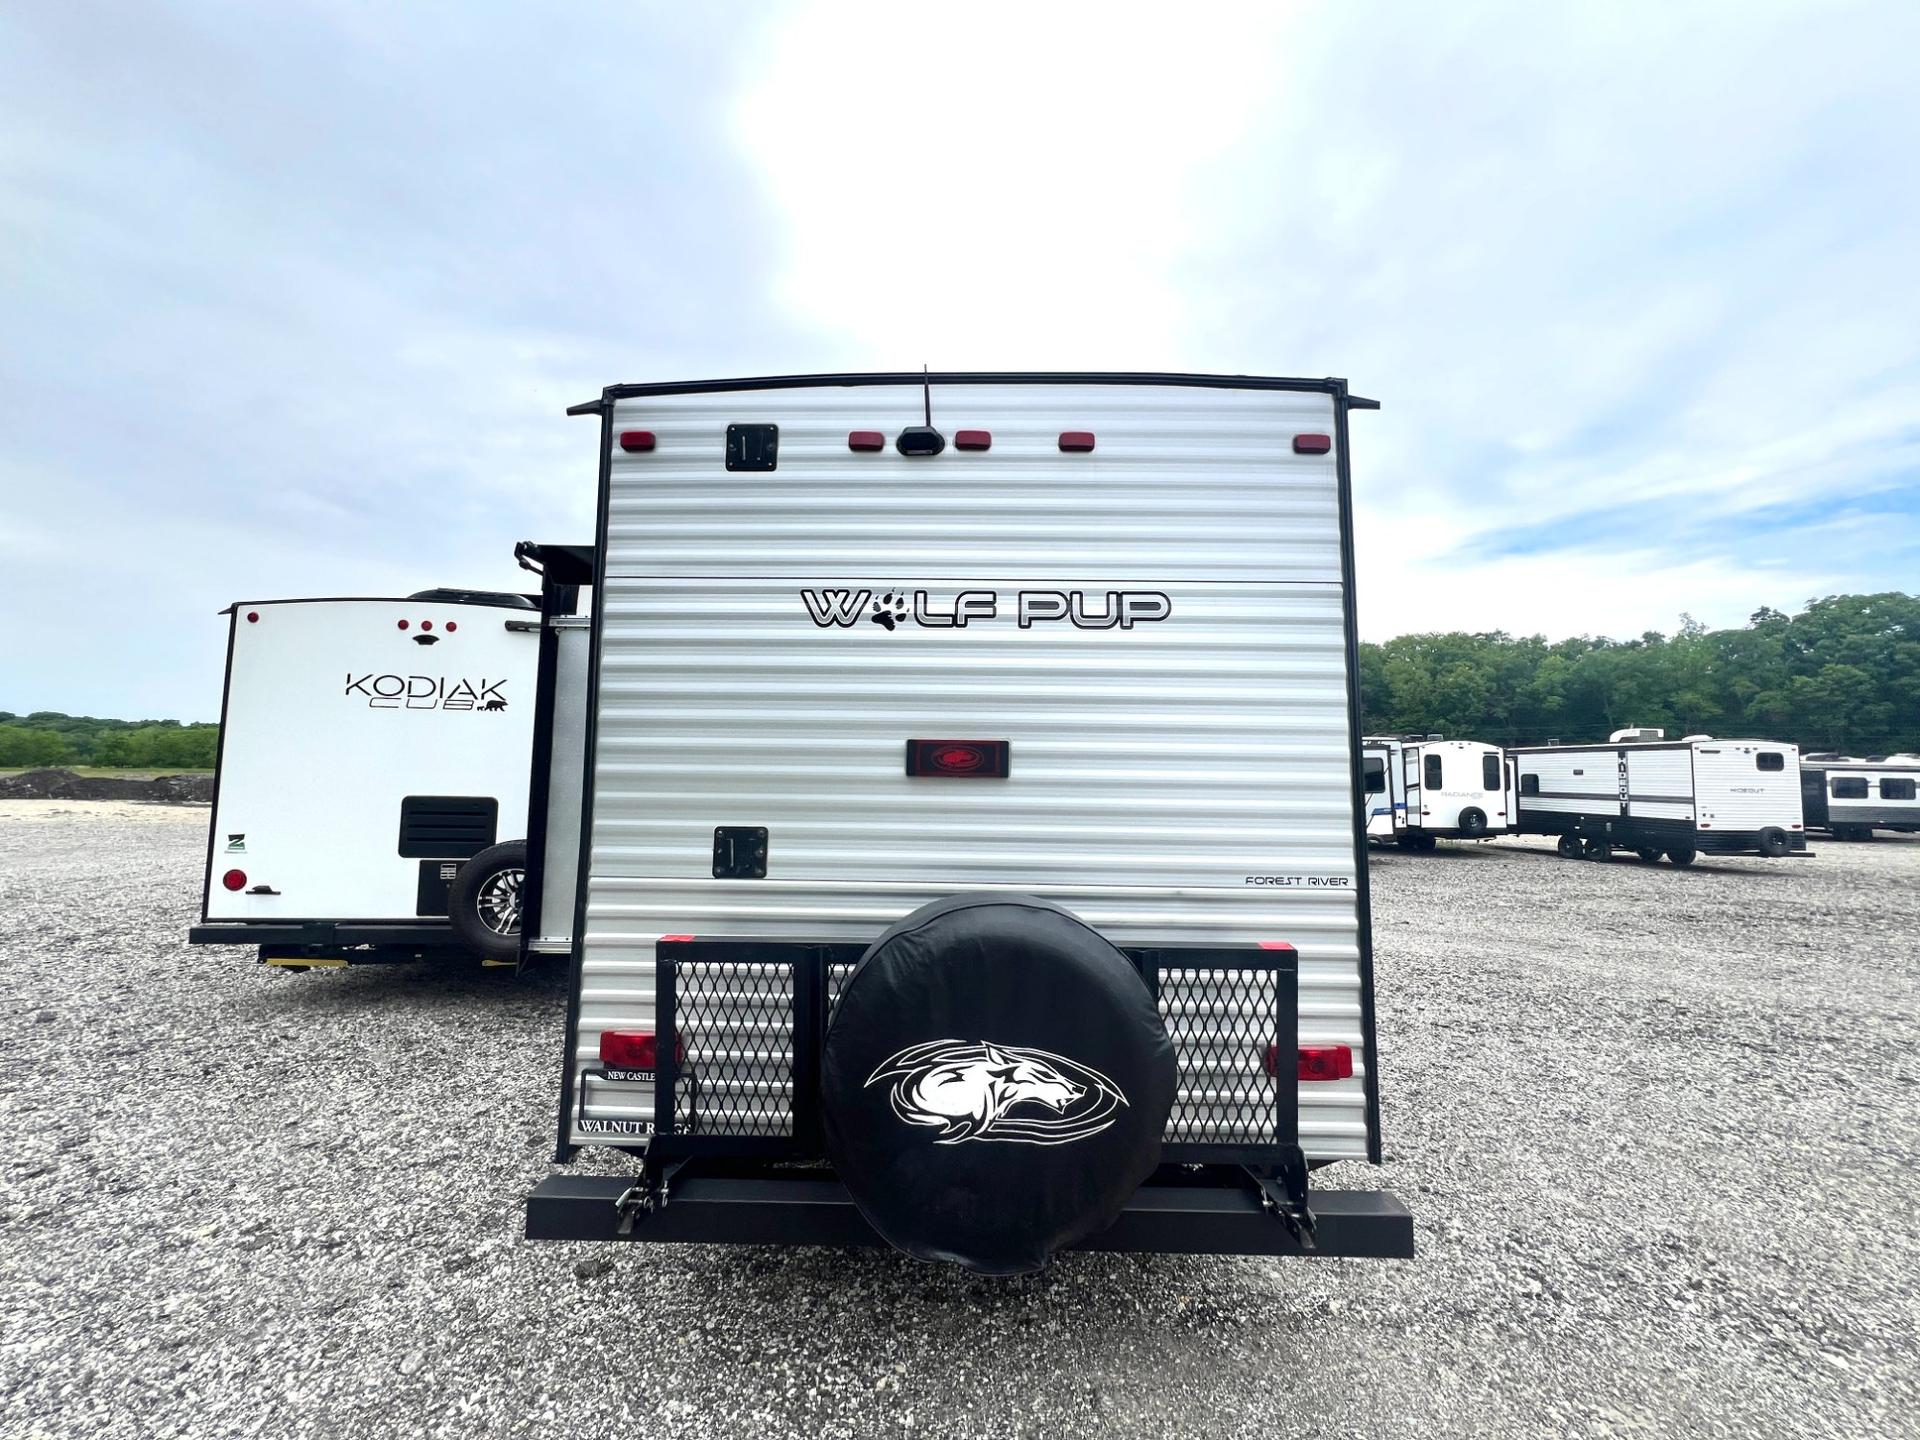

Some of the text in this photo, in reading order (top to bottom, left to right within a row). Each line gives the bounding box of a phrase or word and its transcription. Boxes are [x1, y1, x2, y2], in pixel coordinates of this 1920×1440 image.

[1018, 590, 1172, 630] PUP
[346, 673, 508, 701] KODIAK
[369, 697, 473, 710] CUB
[1245, 876, 1349, 886] FOREST RIVER
[607, 1071, 656, 1081] NEW CASTLE
[580, 1119, 691, 1135] WALNUT RGE
